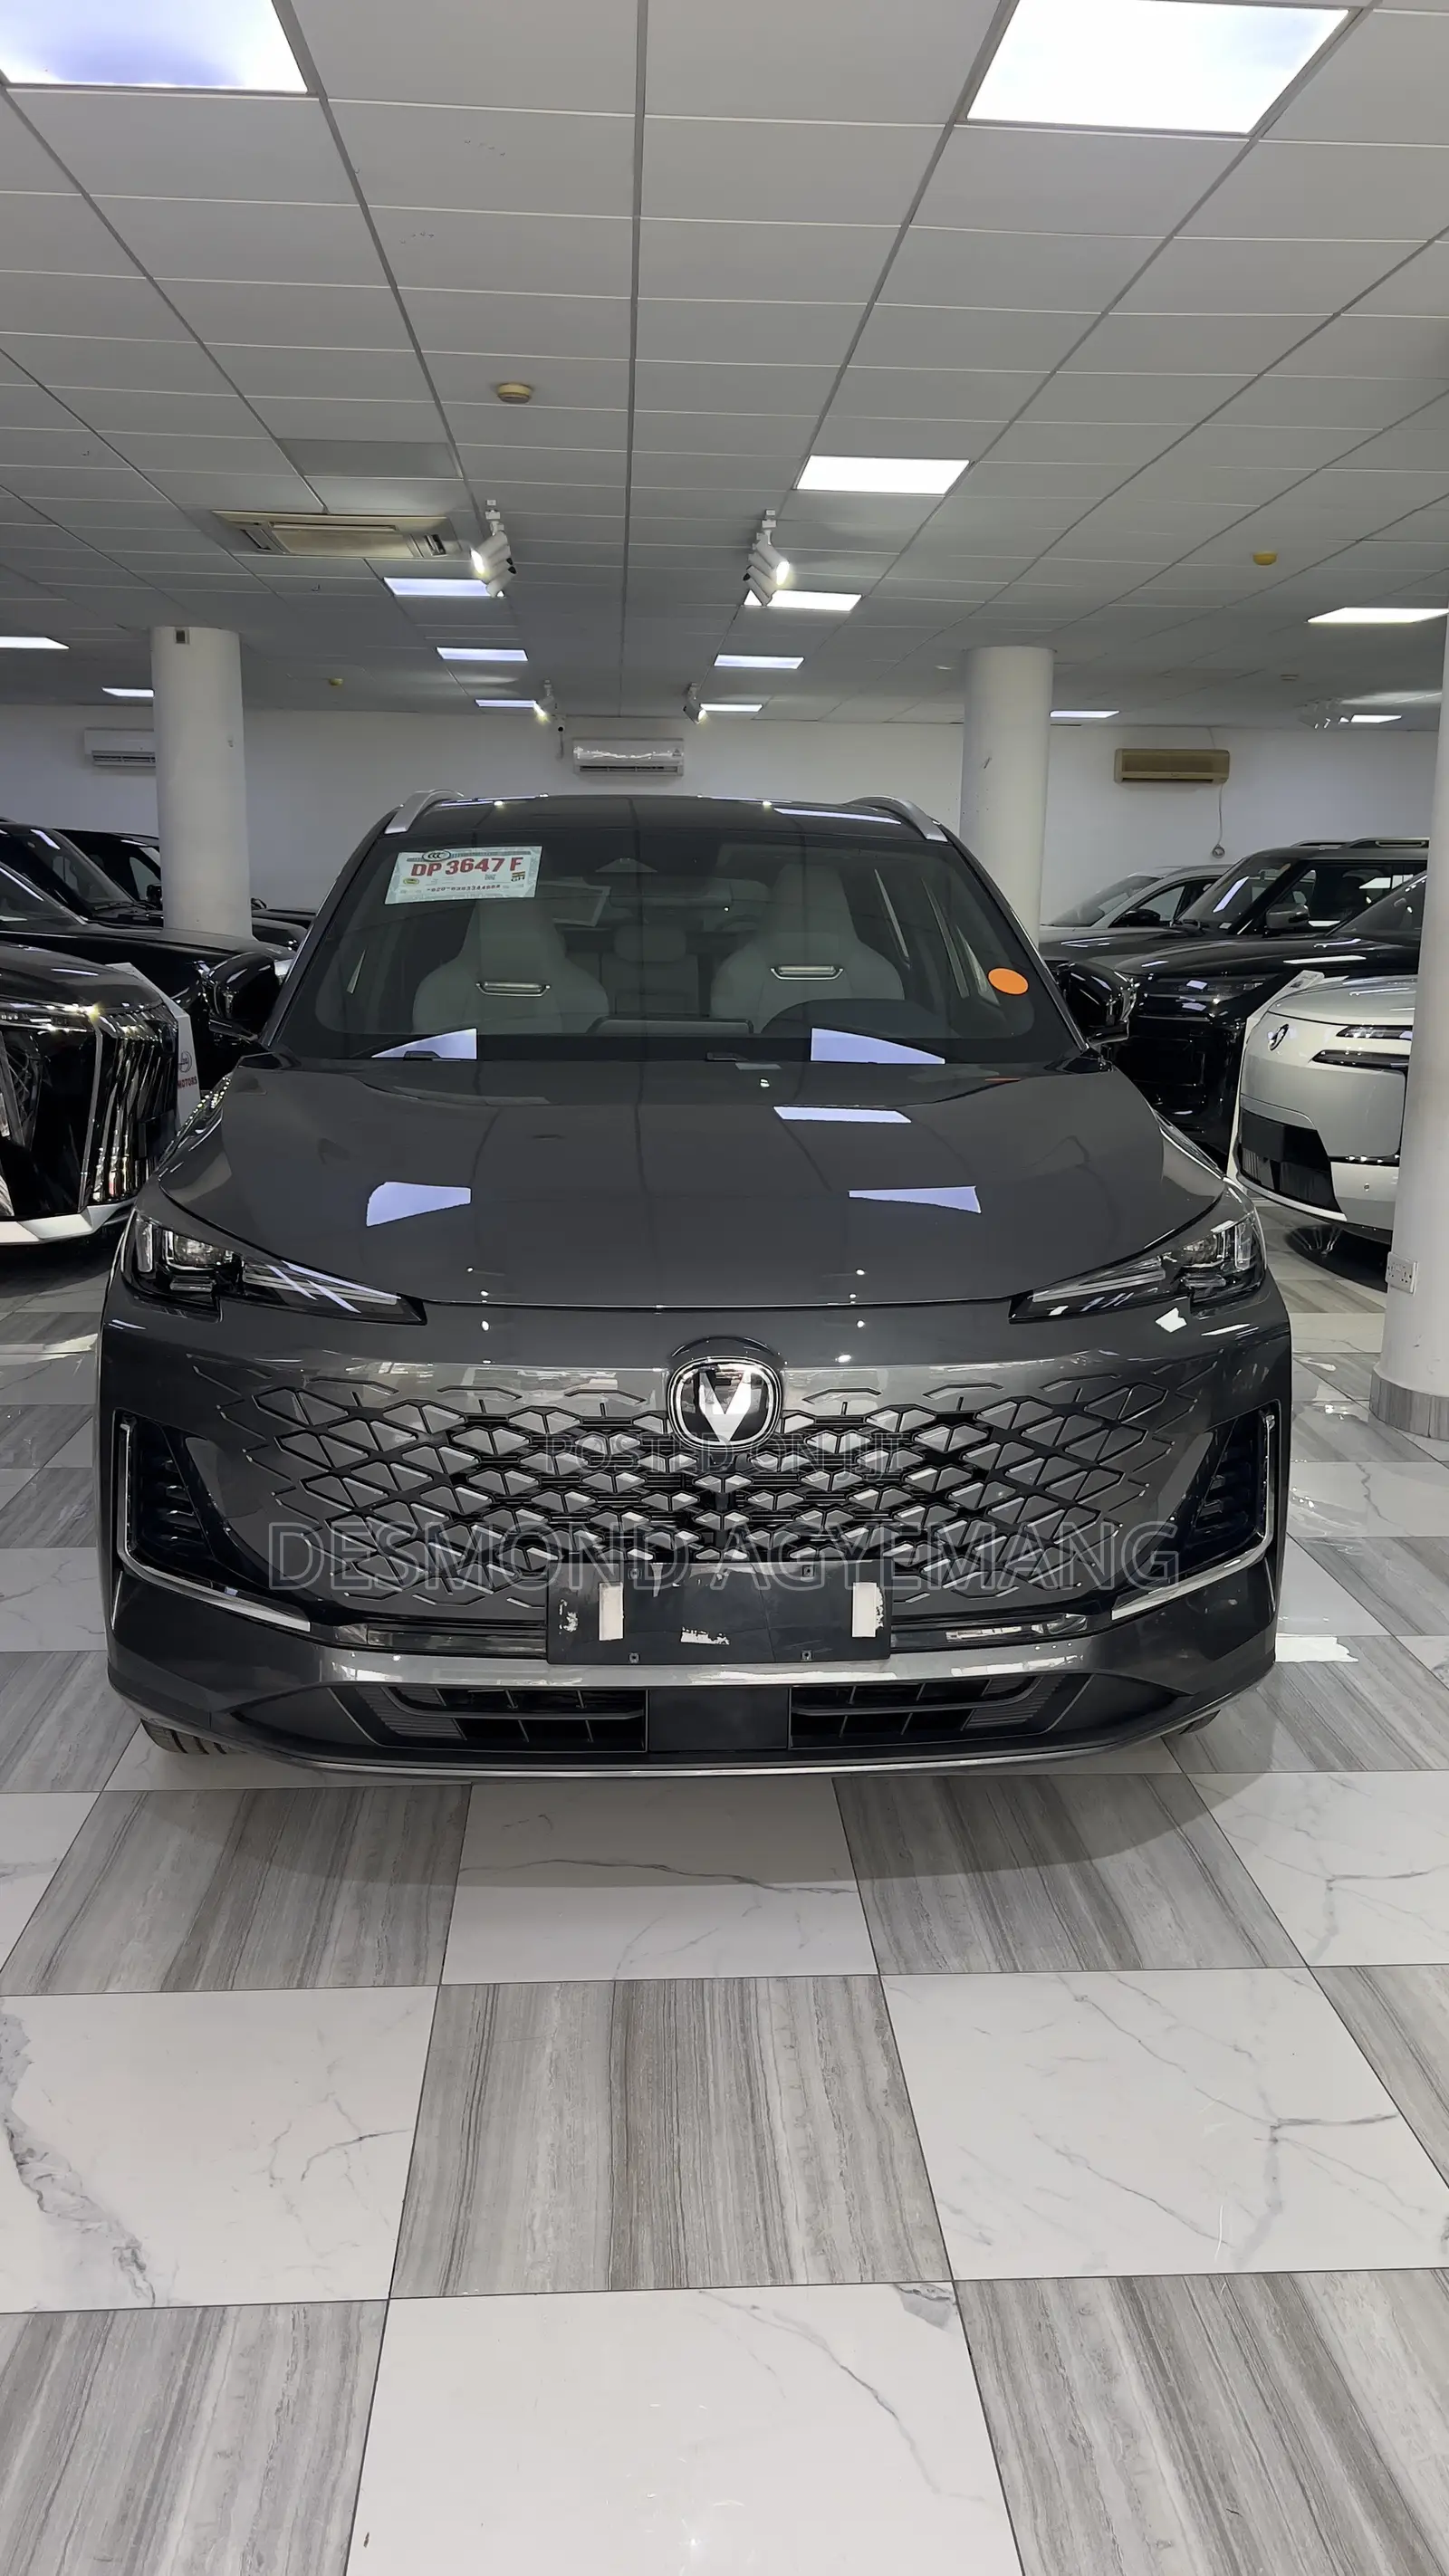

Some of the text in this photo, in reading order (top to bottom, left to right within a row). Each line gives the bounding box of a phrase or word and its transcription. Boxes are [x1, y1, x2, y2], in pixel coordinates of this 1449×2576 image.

[411, 857, 523, 876] DP 3647 F
